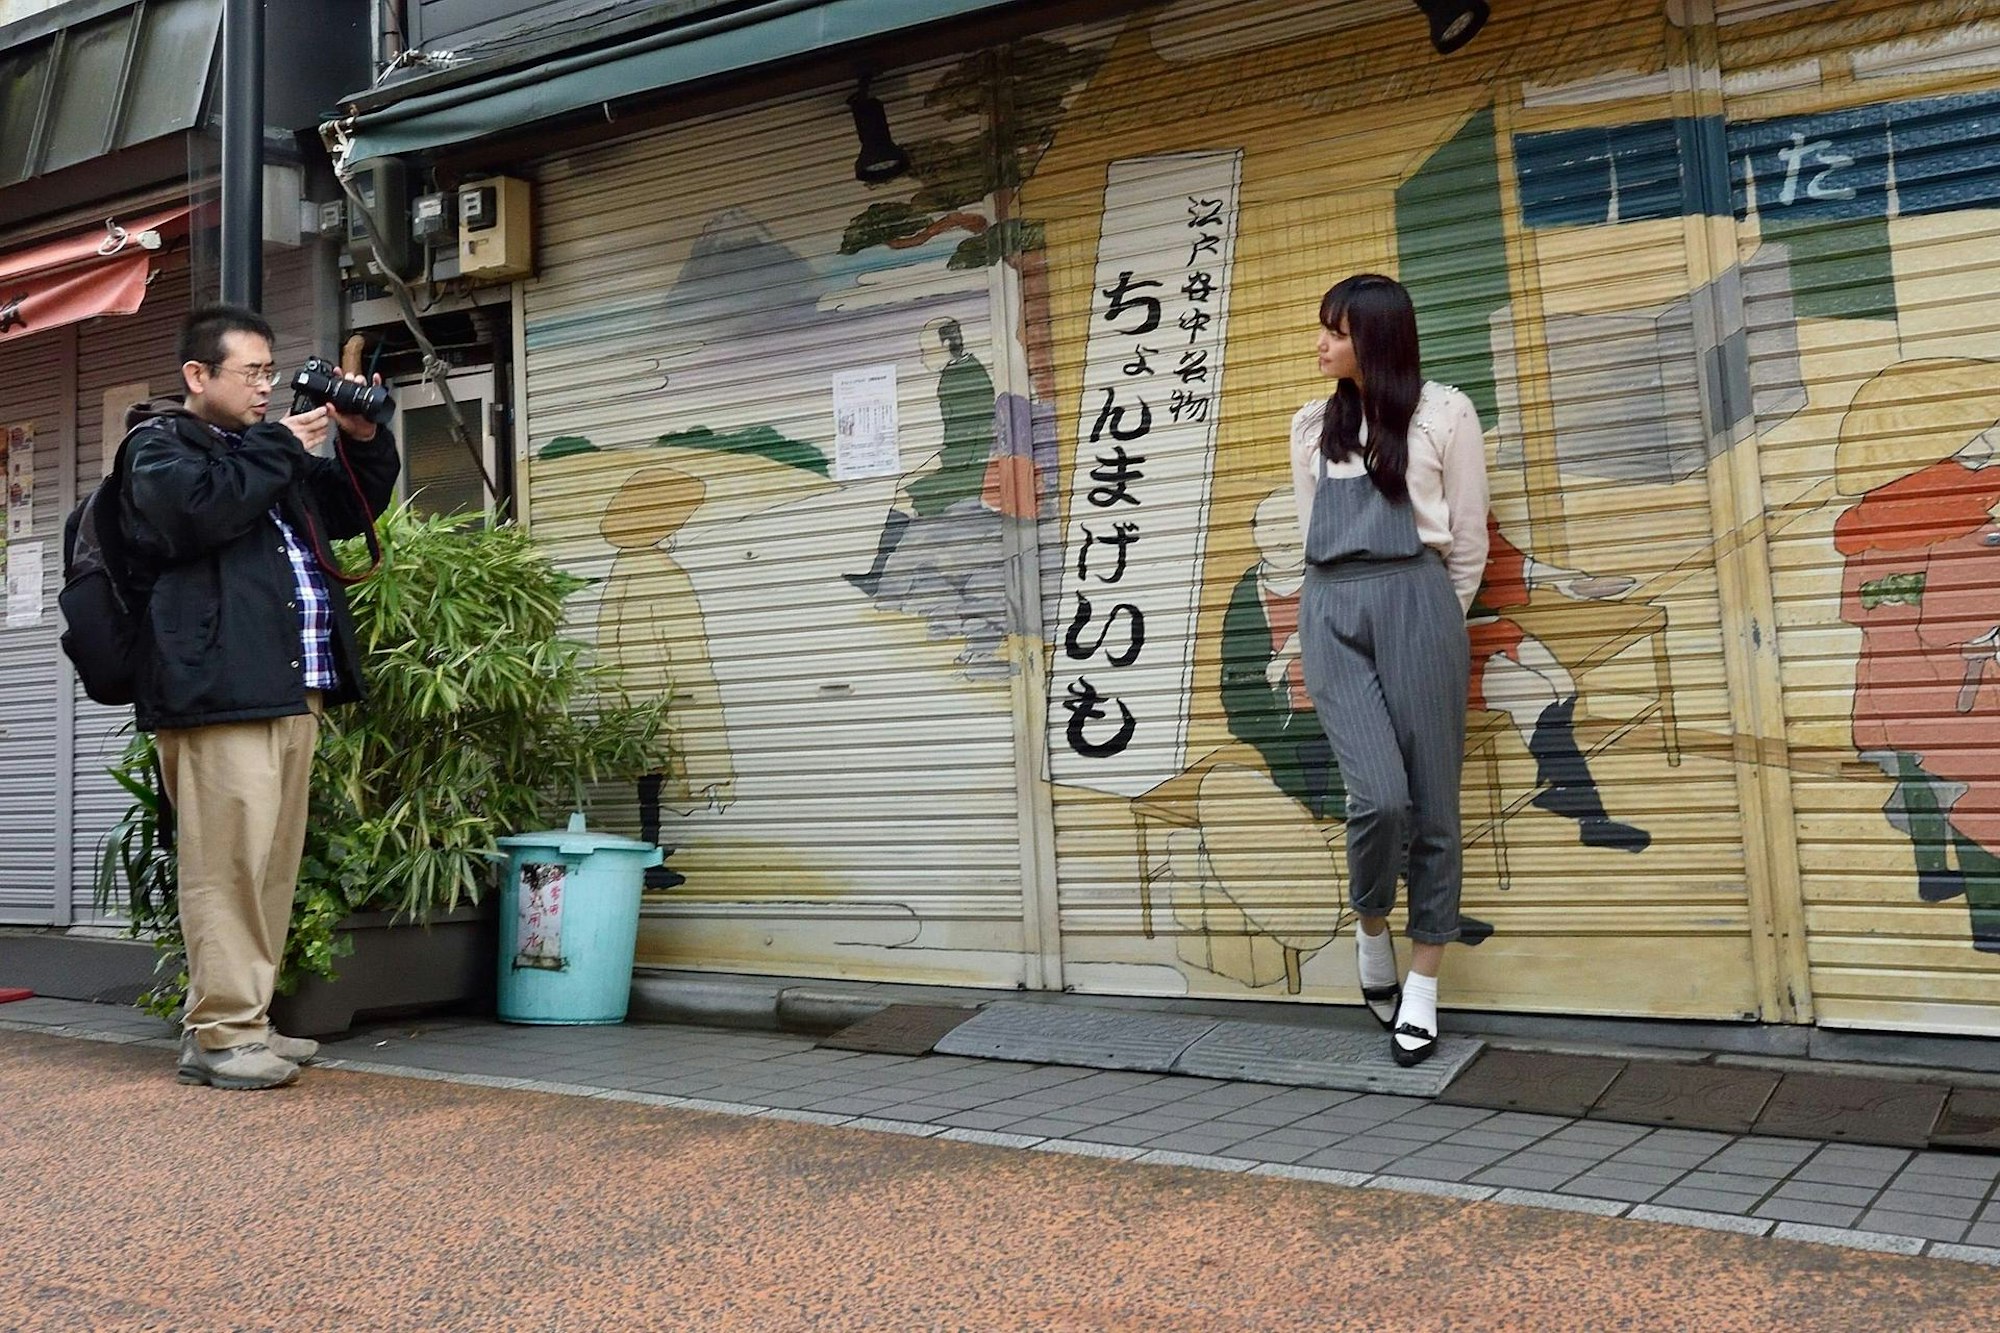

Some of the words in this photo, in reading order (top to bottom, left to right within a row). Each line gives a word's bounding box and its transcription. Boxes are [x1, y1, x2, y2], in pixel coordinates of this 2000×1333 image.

[1062, 271, 1164, 759] ちょんまげいも
